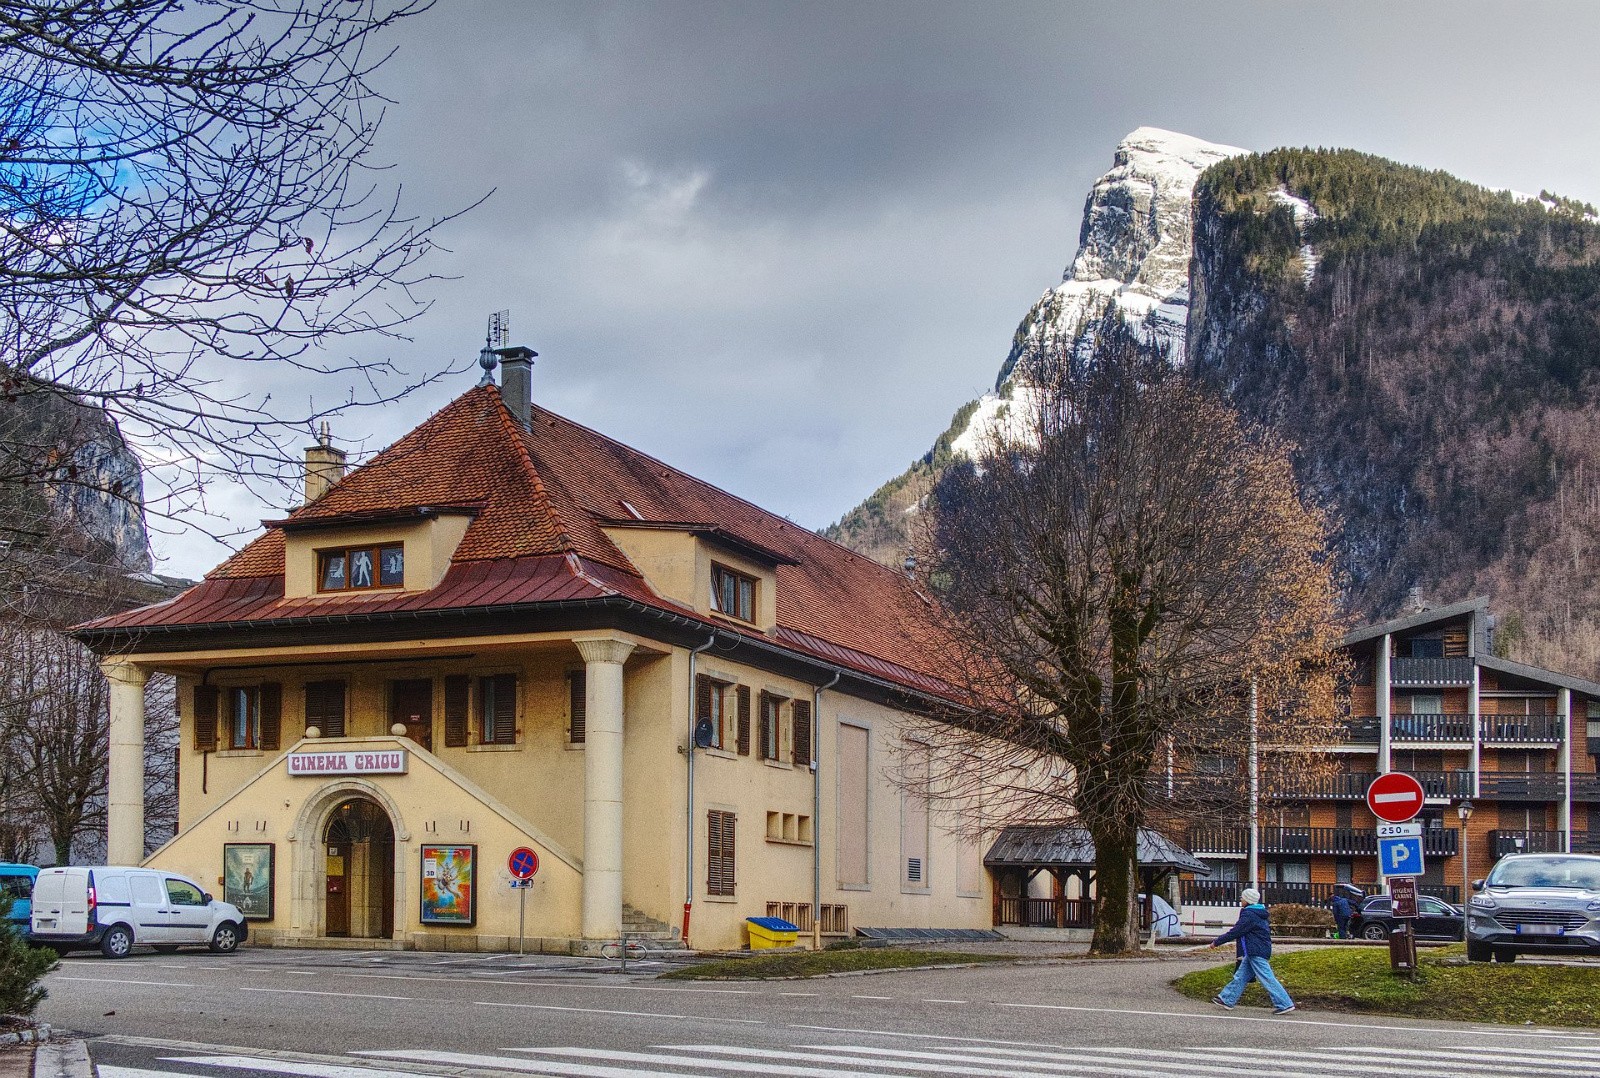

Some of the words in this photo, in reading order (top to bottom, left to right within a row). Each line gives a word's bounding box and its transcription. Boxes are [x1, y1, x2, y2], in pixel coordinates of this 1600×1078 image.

[291, 755, 348, 771] CINEMA
[1381, 827, 1402, 835] 250
[1391, 844, 1410, 869] P
